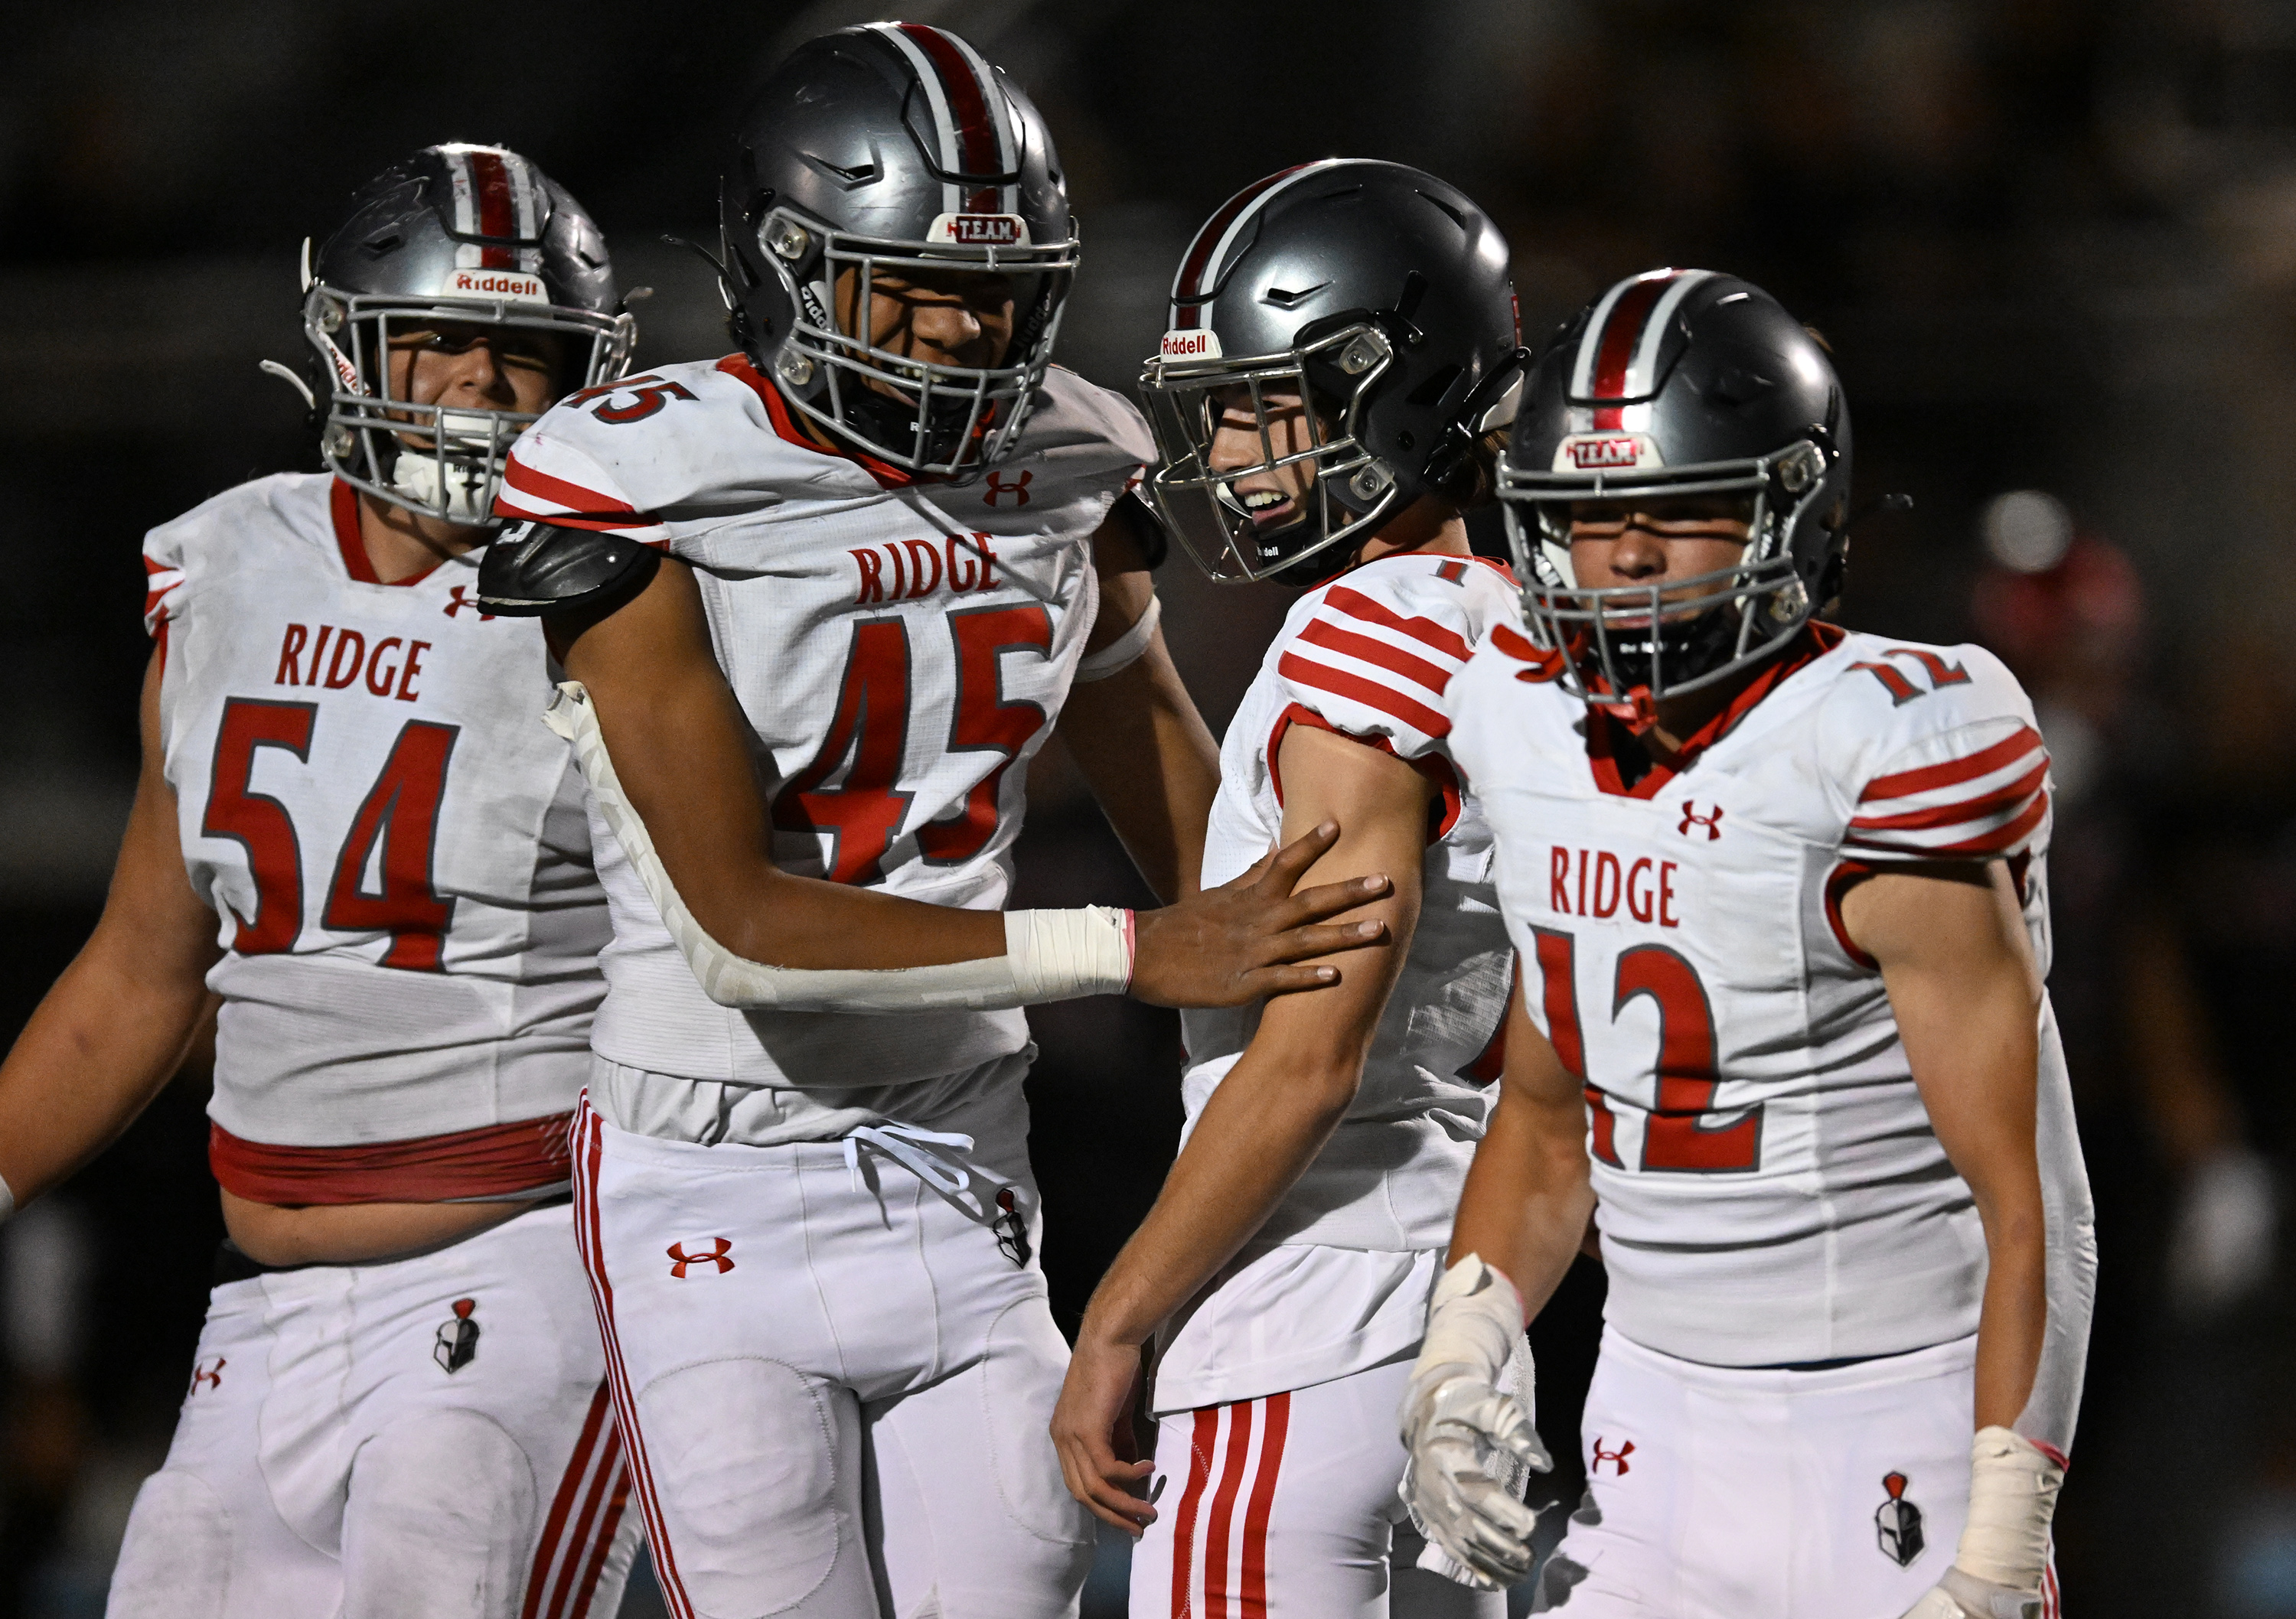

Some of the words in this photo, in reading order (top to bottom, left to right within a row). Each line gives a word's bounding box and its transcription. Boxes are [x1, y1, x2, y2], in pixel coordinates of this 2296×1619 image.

[457, 274, 537, 295] Riddell
[1163, 334, 1206, 355] Riddell
[561, 375, 700, 425] 45
[848, 532, 1002, 604] RIDGE
[275, 623, 432, 702] RIDGE
[1845, 649, 1972, 709] 12
[771, 601, 1054, 886] 45
[201, 695, 462, 973] 54
[1551, 845, 1680, 928] RIDGE
[1528, 922, 1764, 1173] 12
